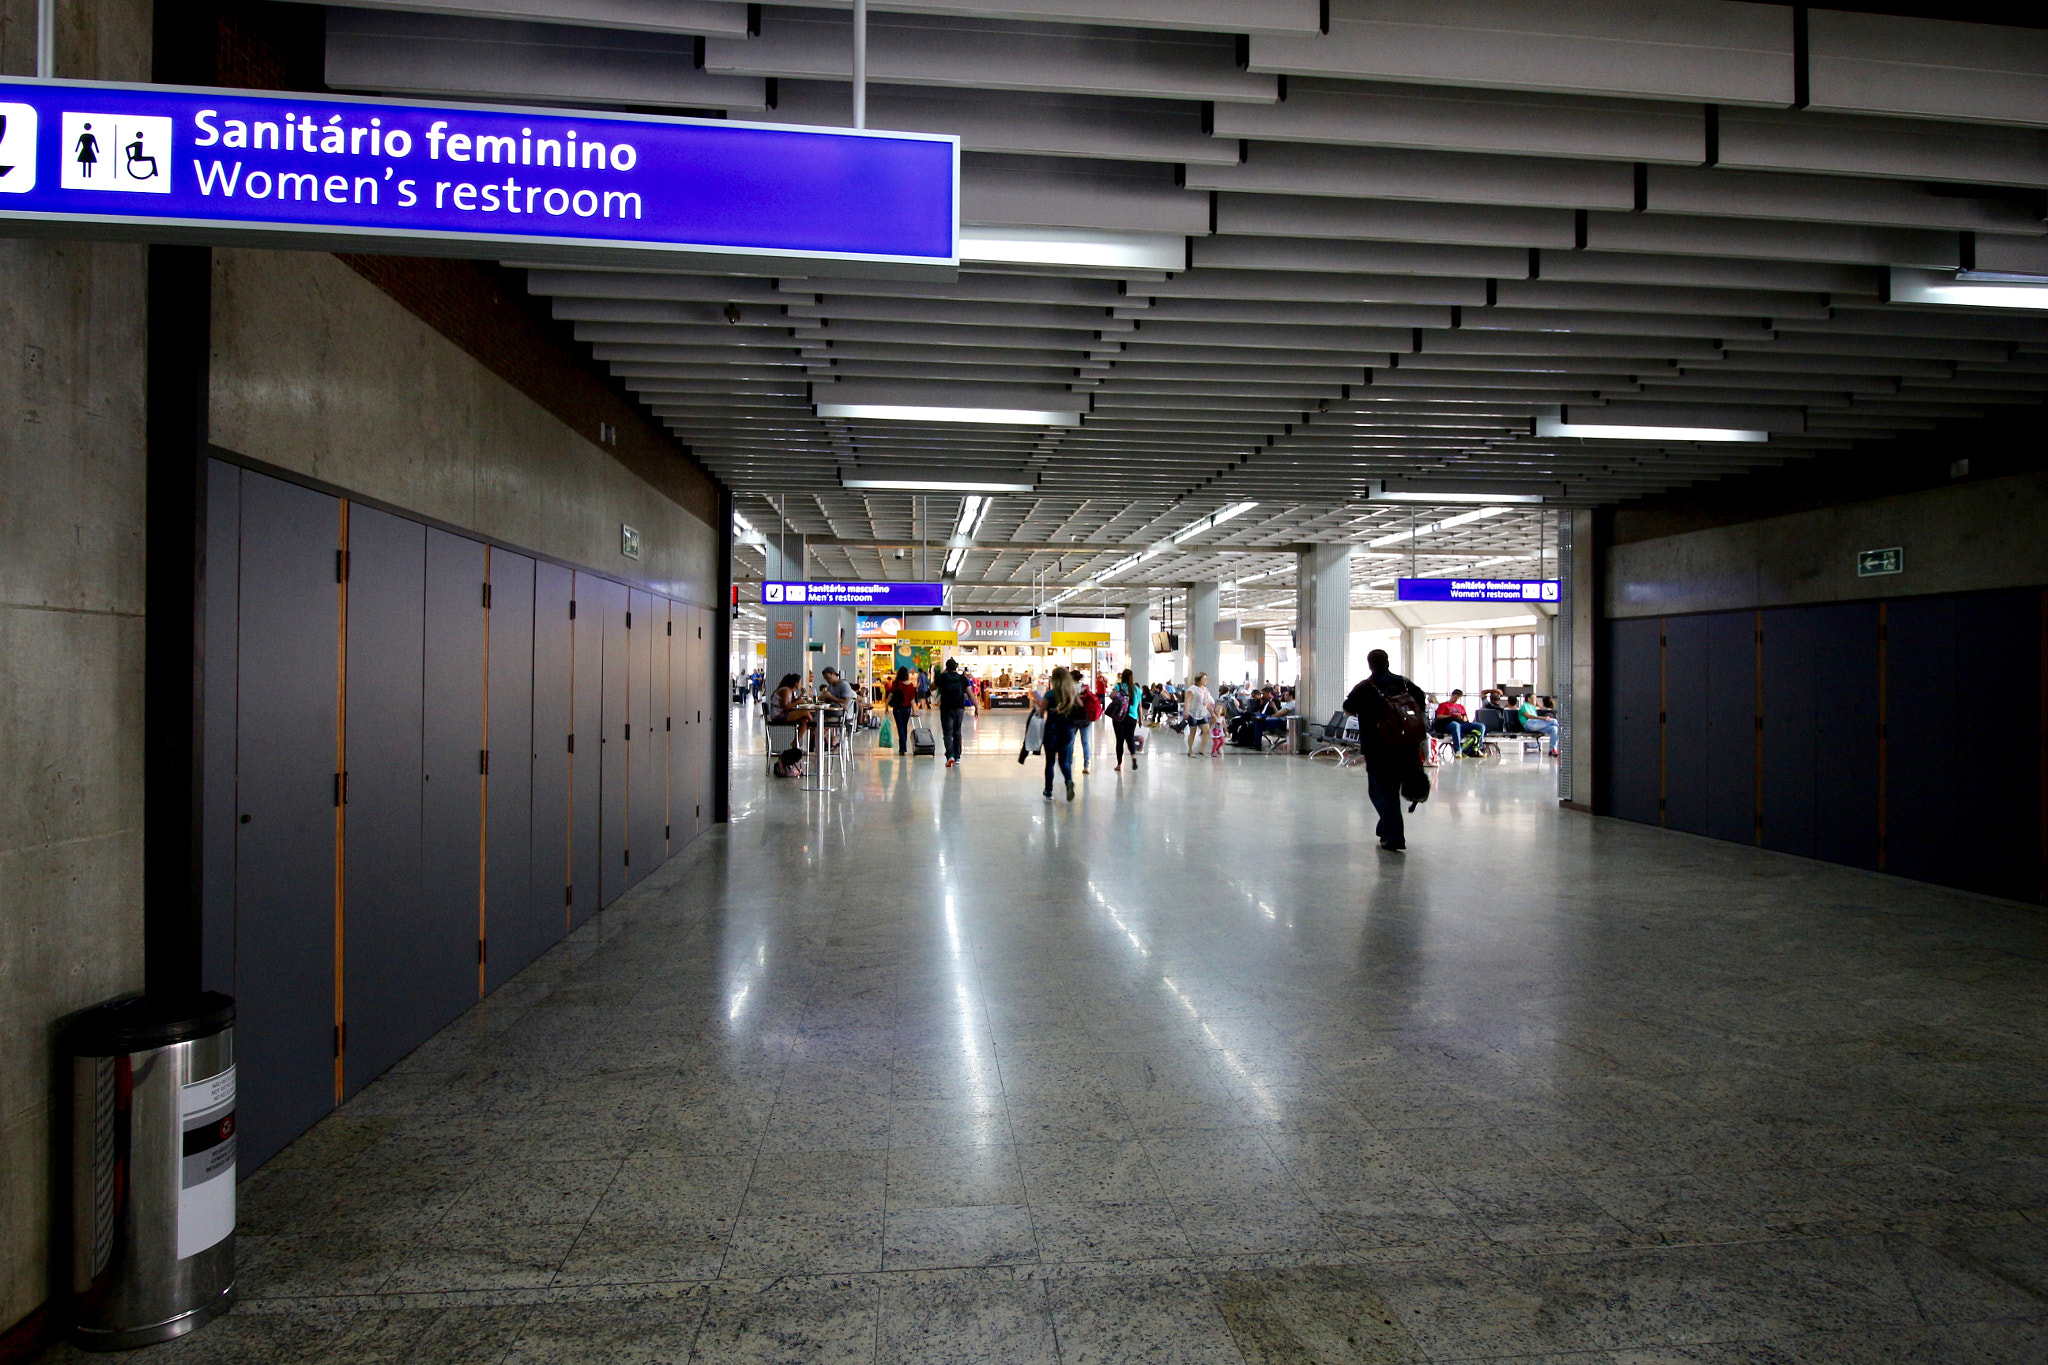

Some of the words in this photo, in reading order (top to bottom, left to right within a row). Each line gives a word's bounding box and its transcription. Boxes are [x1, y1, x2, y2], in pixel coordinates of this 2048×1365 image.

[194, 109, 412, 161] Sanitário
[425, 120, 637, 172] feminino
[193, 159, 418, 207] Women's
[435, 177, 642, 220] restroom
[808, 584, 847, 593] Sanitário
[847, 584, 891, 593] masculino
[1451, 581, 1486, 590] Sanitário
[1486, 581, 1521, 590] feminino
[808, 593, 834, 602] Men's
[834, 594, 873, 602] restroom
[1450, 590, 1486, 598] Women's
[1487, 590, 1521, 599] restroom
[861, 621, 879, 629] 2016
[975, 620, 1020, 628] DUFRY
